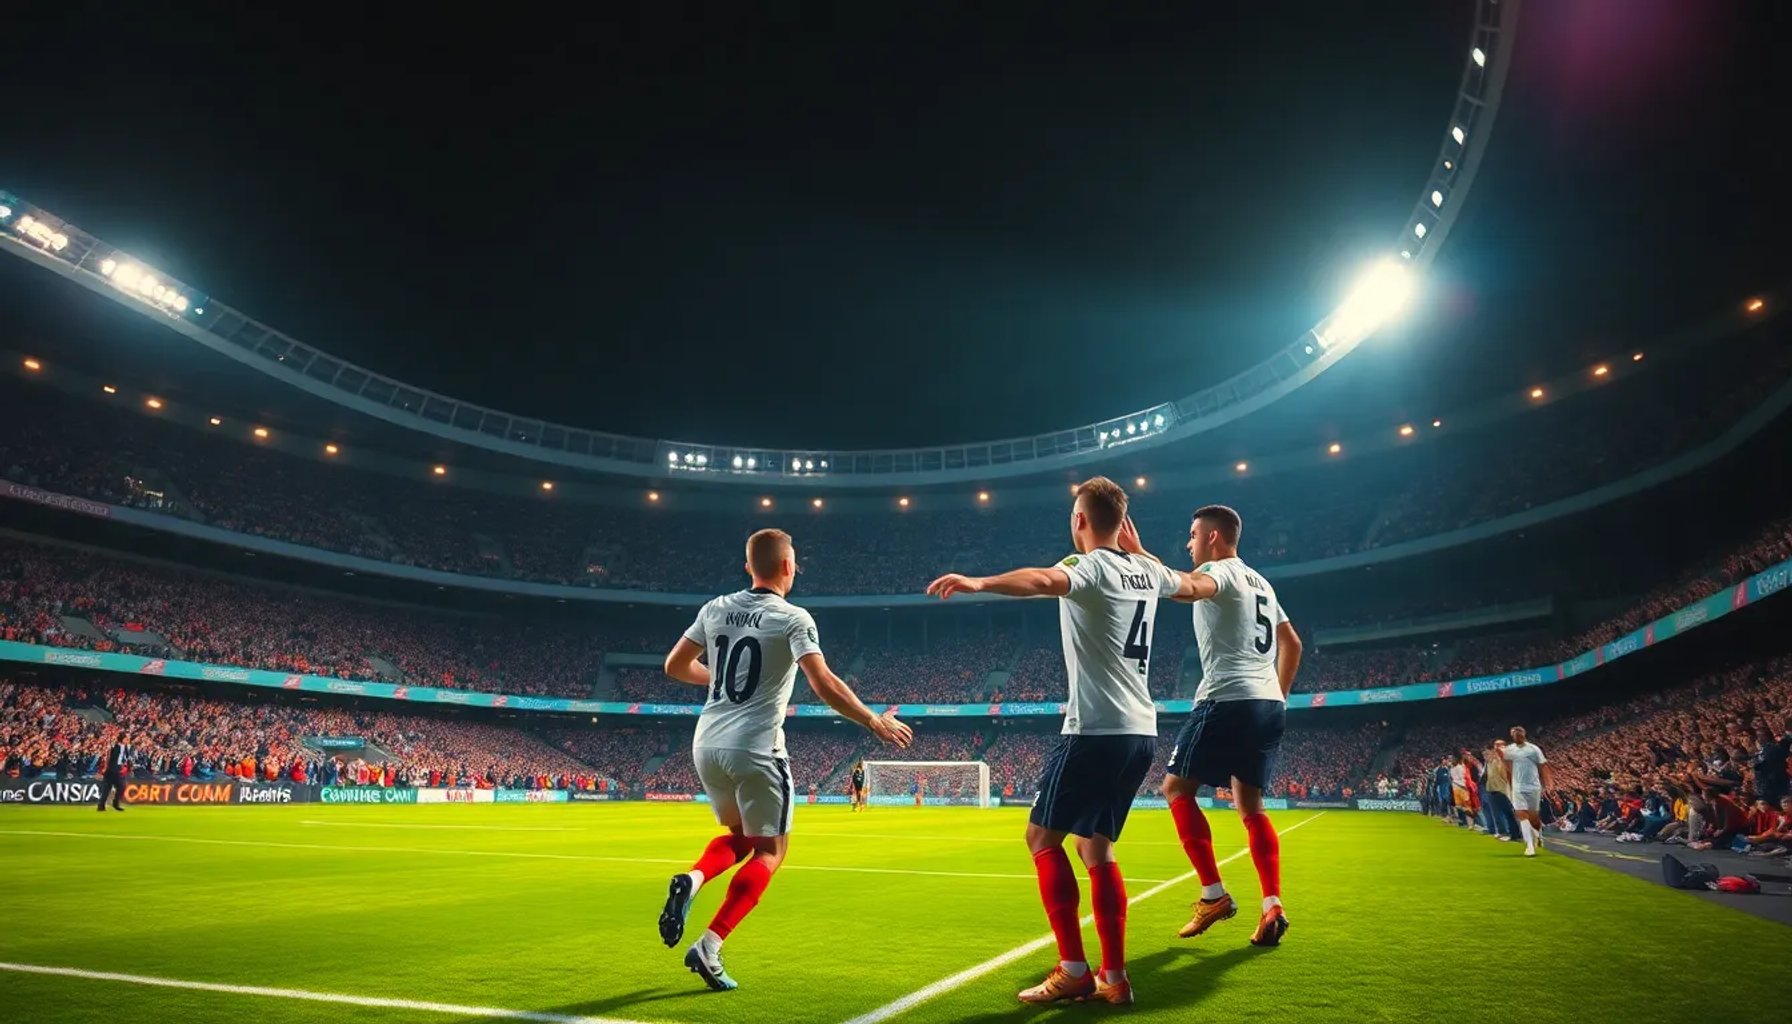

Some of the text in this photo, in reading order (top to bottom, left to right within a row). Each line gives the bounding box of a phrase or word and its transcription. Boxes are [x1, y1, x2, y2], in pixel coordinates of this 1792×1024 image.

[1123, 600, 1149, 674] 4
[1255, 595, 1273, 654] 5
[713, 634, 763, 705] 10
